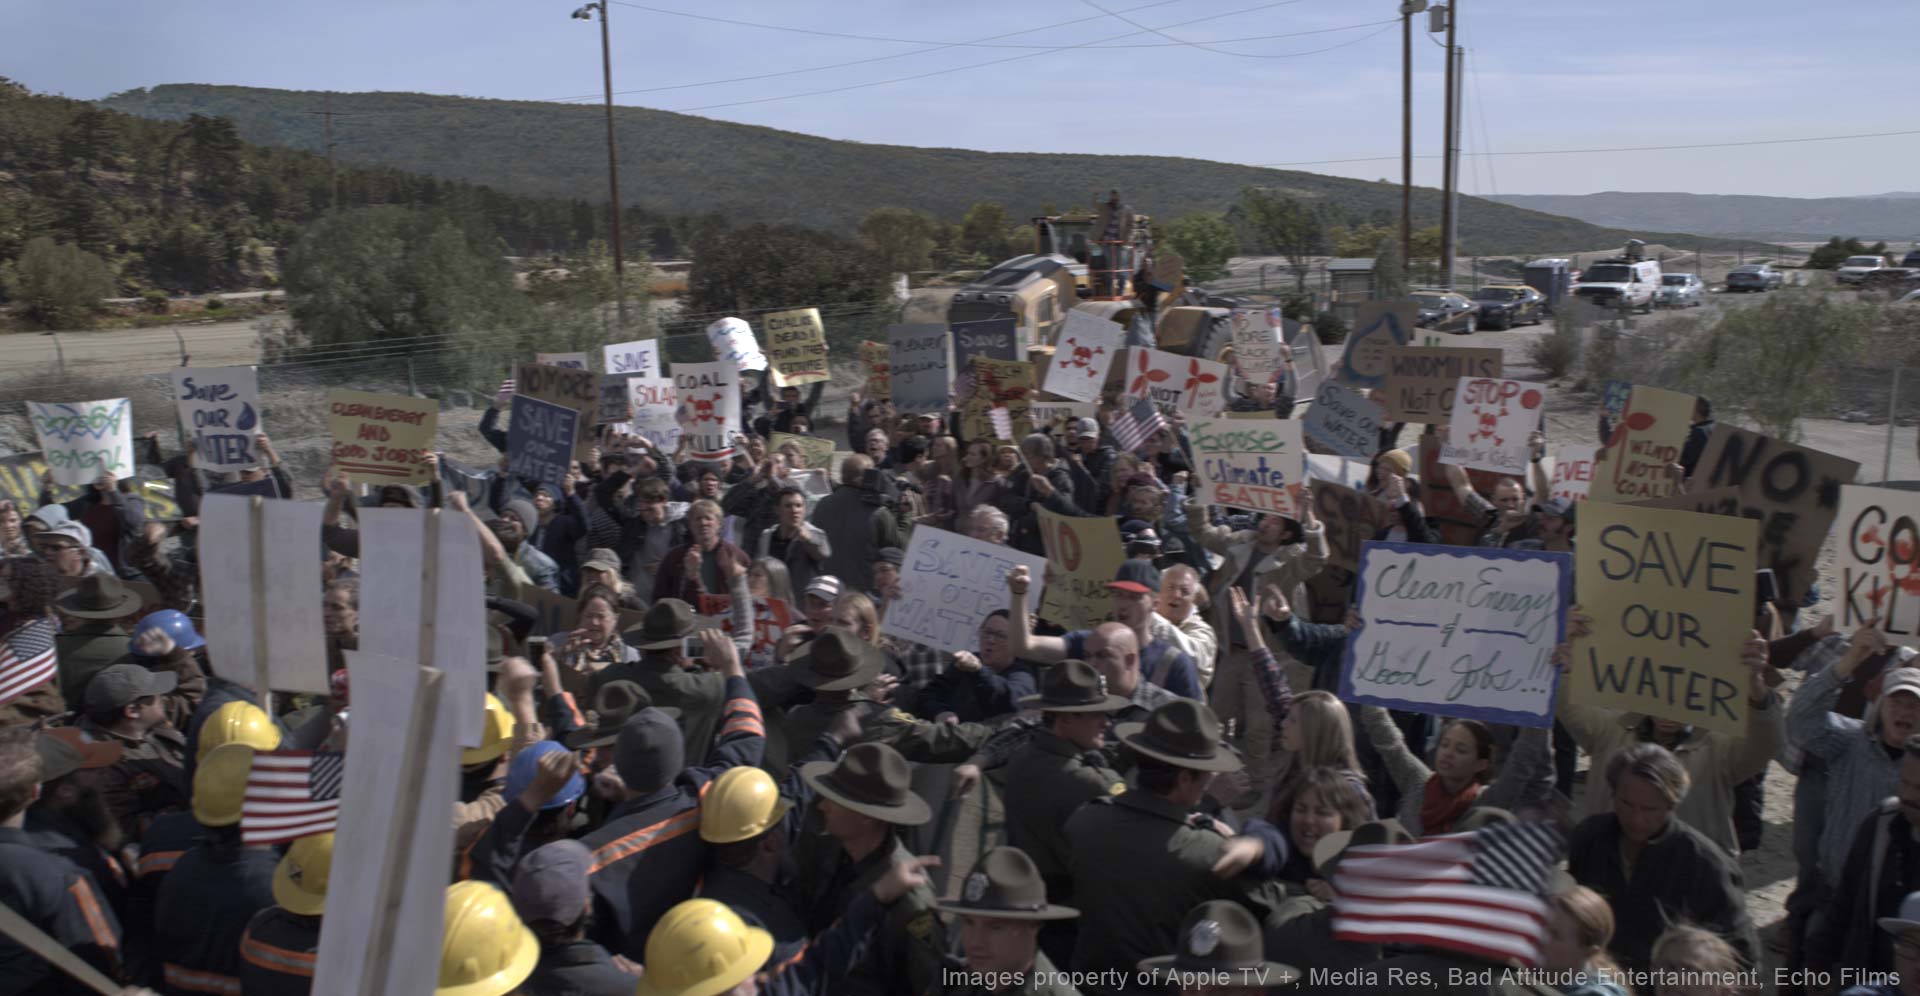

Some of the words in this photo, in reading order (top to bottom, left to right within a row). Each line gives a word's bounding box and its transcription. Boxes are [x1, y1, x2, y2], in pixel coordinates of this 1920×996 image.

[613, 350, 651, 372] SAVE
[676, 372, 729, 389] COAL
[1463, 379, 1520, 406] STOP
[357, 423, 391, 442] AND
[520, 404, 573, 445] SAVE
[1189, 422, 1285, 458] Expose
[1630, 440, 1678, 462] WIND
[1711, 433, 1808, 503] NO
[1204, 456, 1284, 488] Climate
[1599, 524, 1745, 594] SAVE
[1375, 558, 1464, 602] Clean
[1466, 567, 1558, 644] Energy
[1844, 567, 1920, 635] KIL
[1621, 604, 1711, 648] OUR
[1357, 641, 1435, 687] Good
[1589, 647, 1739, 721] WATER
